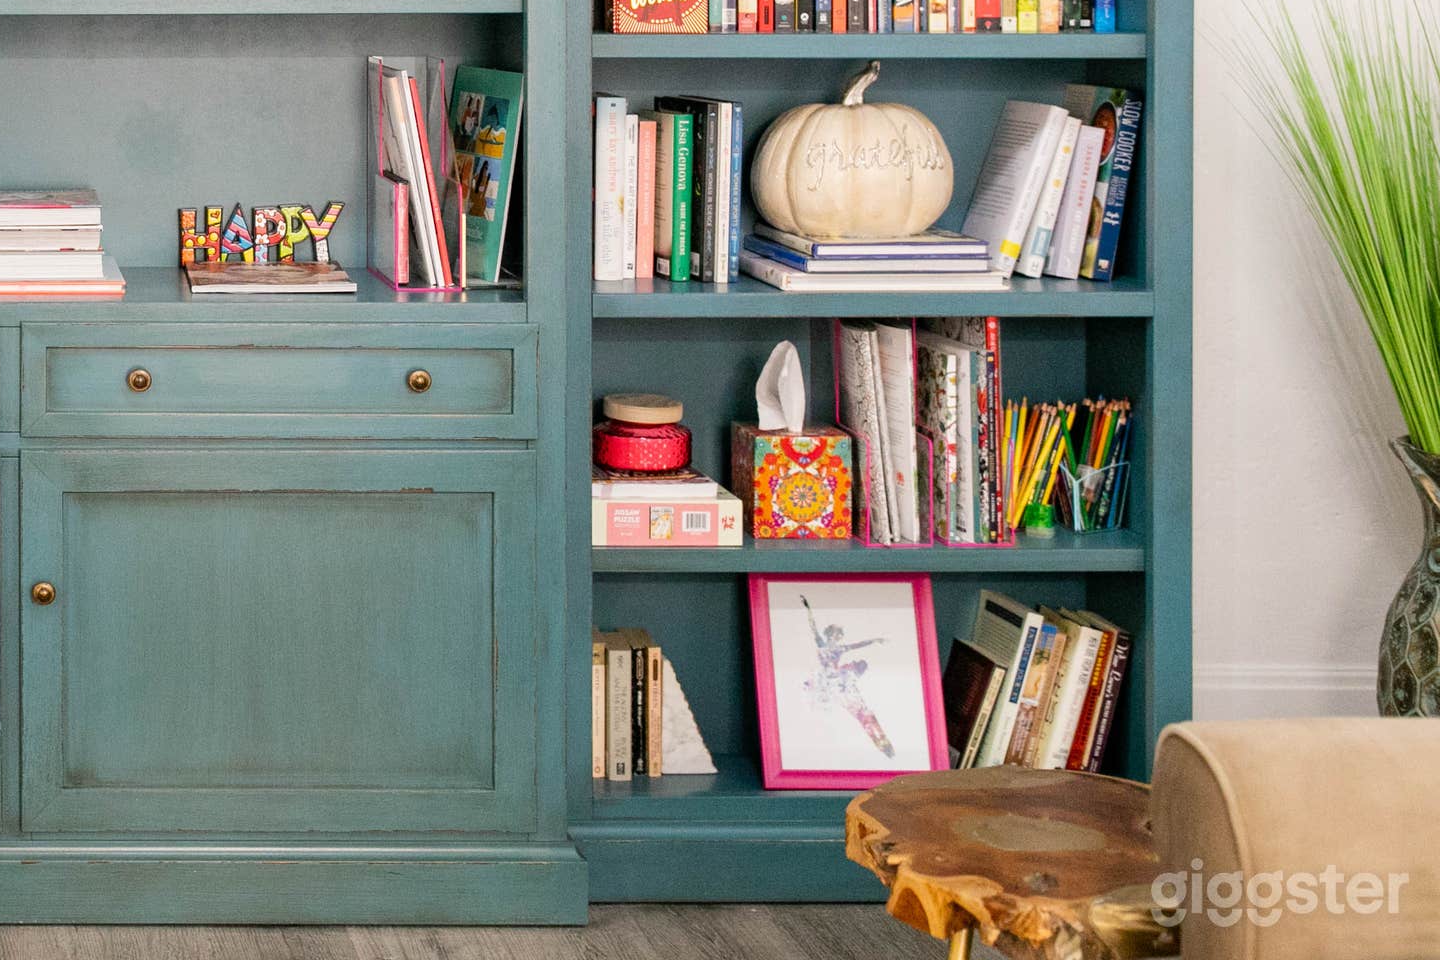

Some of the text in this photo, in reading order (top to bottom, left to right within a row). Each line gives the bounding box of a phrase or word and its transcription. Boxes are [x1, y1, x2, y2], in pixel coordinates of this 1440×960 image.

[677, 120, 689, 191] Lisa Genova
[806, 123, 945, 192] grateful
[1114, 98, 1143, 173] SLOW COOKER
[177, 202, 345, 268] HAPPY
[613, 516, 641, 524] PUZZLE
